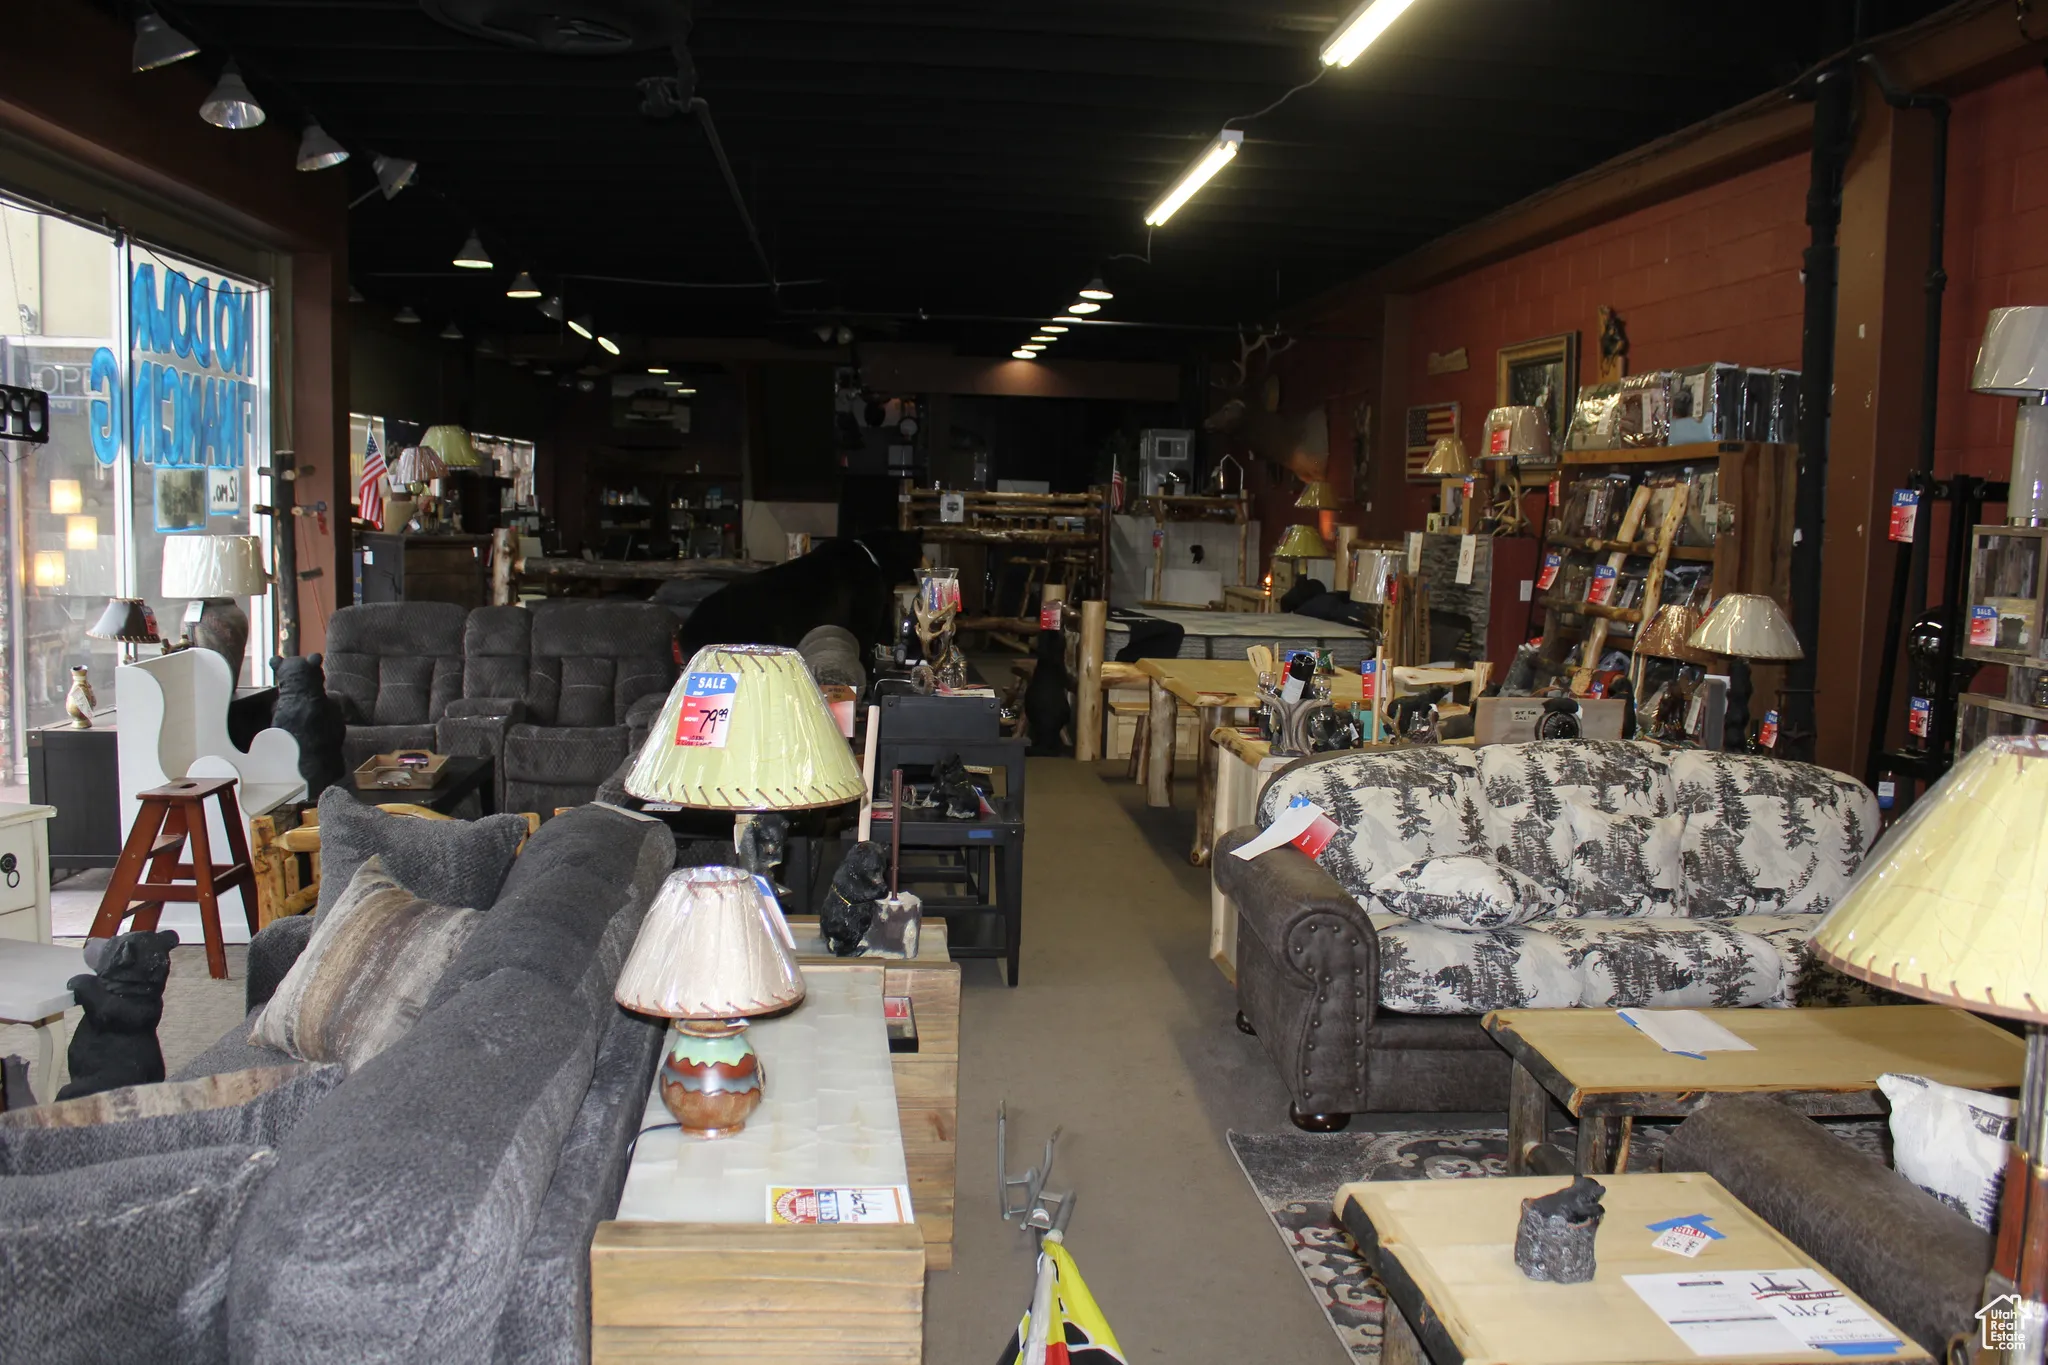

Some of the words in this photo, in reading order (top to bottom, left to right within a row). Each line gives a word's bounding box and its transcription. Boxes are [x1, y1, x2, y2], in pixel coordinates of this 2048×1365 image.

[1898, 493, 1914, 502] SALE
[1549, 557, 1558, 565] SALE
[1600, 568, 1613, 576] SALE
[1977, 608, 1991, 616] SALE
[698, 677, 727, 689] SALE
[1914, 700, 1926, 709] SALE
[820, 1190, 838, 1221] SALE
